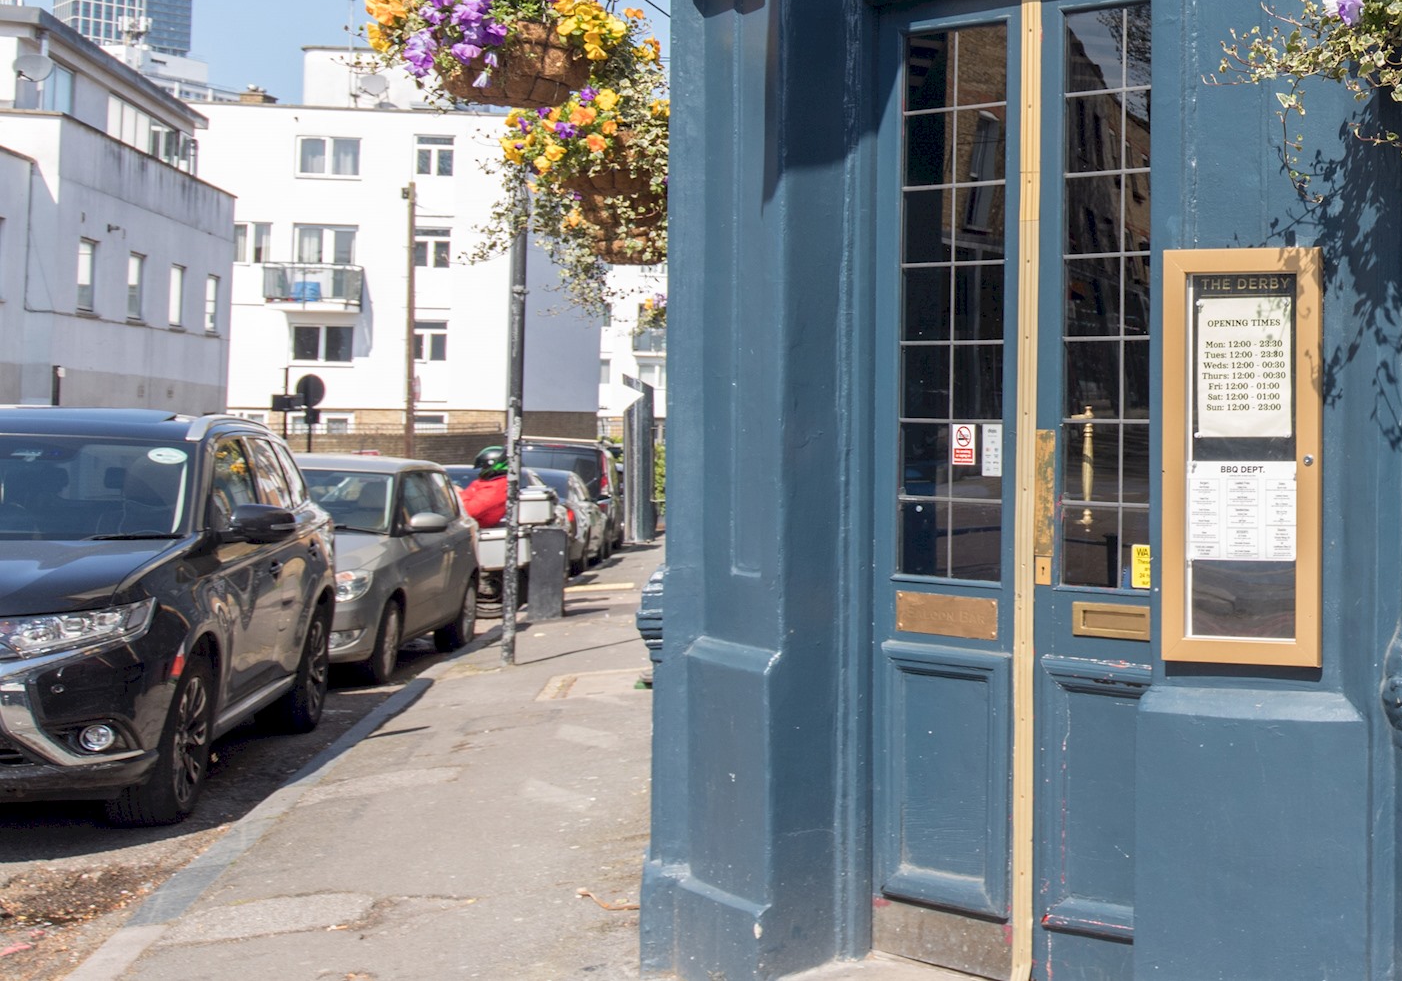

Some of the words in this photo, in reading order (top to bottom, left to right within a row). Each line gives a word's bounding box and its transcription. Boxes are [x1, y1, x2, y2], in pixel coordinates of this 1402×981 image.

[1201, 278, 1231, 290] THE
[1237, 277, 1291, 290] DERBY
[1207, 319, 1249, 328] OPENING
[1250, 318, 1281, 327] TIMES
[1259, 340, 1283, 348] 23:30
[1260, 350, 1284, 358] 23:30
[1203, 361, 1229, 369] Weds:
[1231, 361, 1254, 369] 12:00
[1256, 382, 1280, 390] 01:00
[1258, 403, 1281, 411] 23:00
[1220, 465, 1239, 474] BBQ
[1241, 465, 1266, 474] DEPT.
